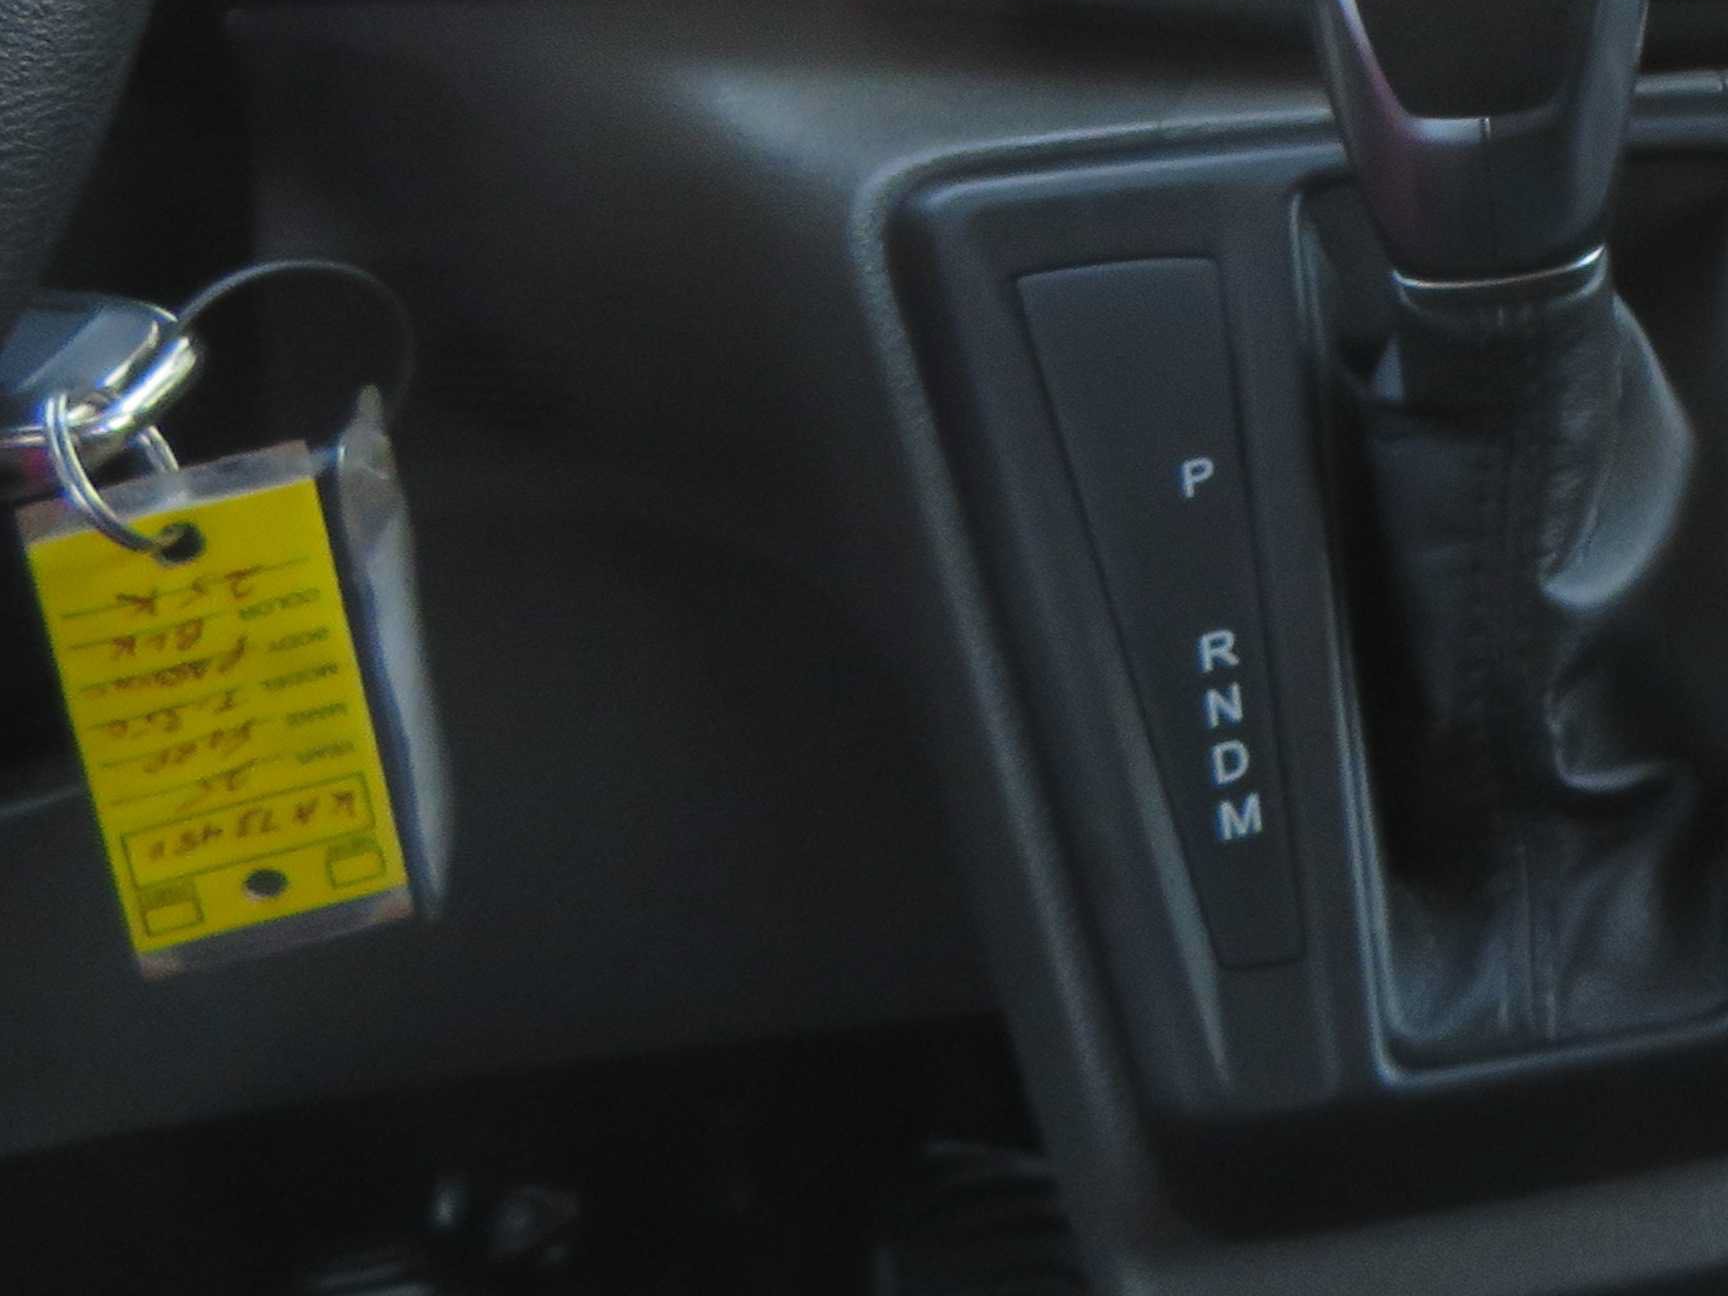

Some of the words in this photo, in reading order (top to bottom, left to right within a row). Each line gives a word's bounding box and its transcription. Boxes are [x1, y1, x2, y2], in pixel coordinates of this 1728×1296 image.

[1182, 456, 1215, 499] P
[1199, 628, 1241, 672] R
[1206, 681, 1245, 730] N
[1212, 738, 1251, 786] D
[1218, 791, 1264, 843] M
